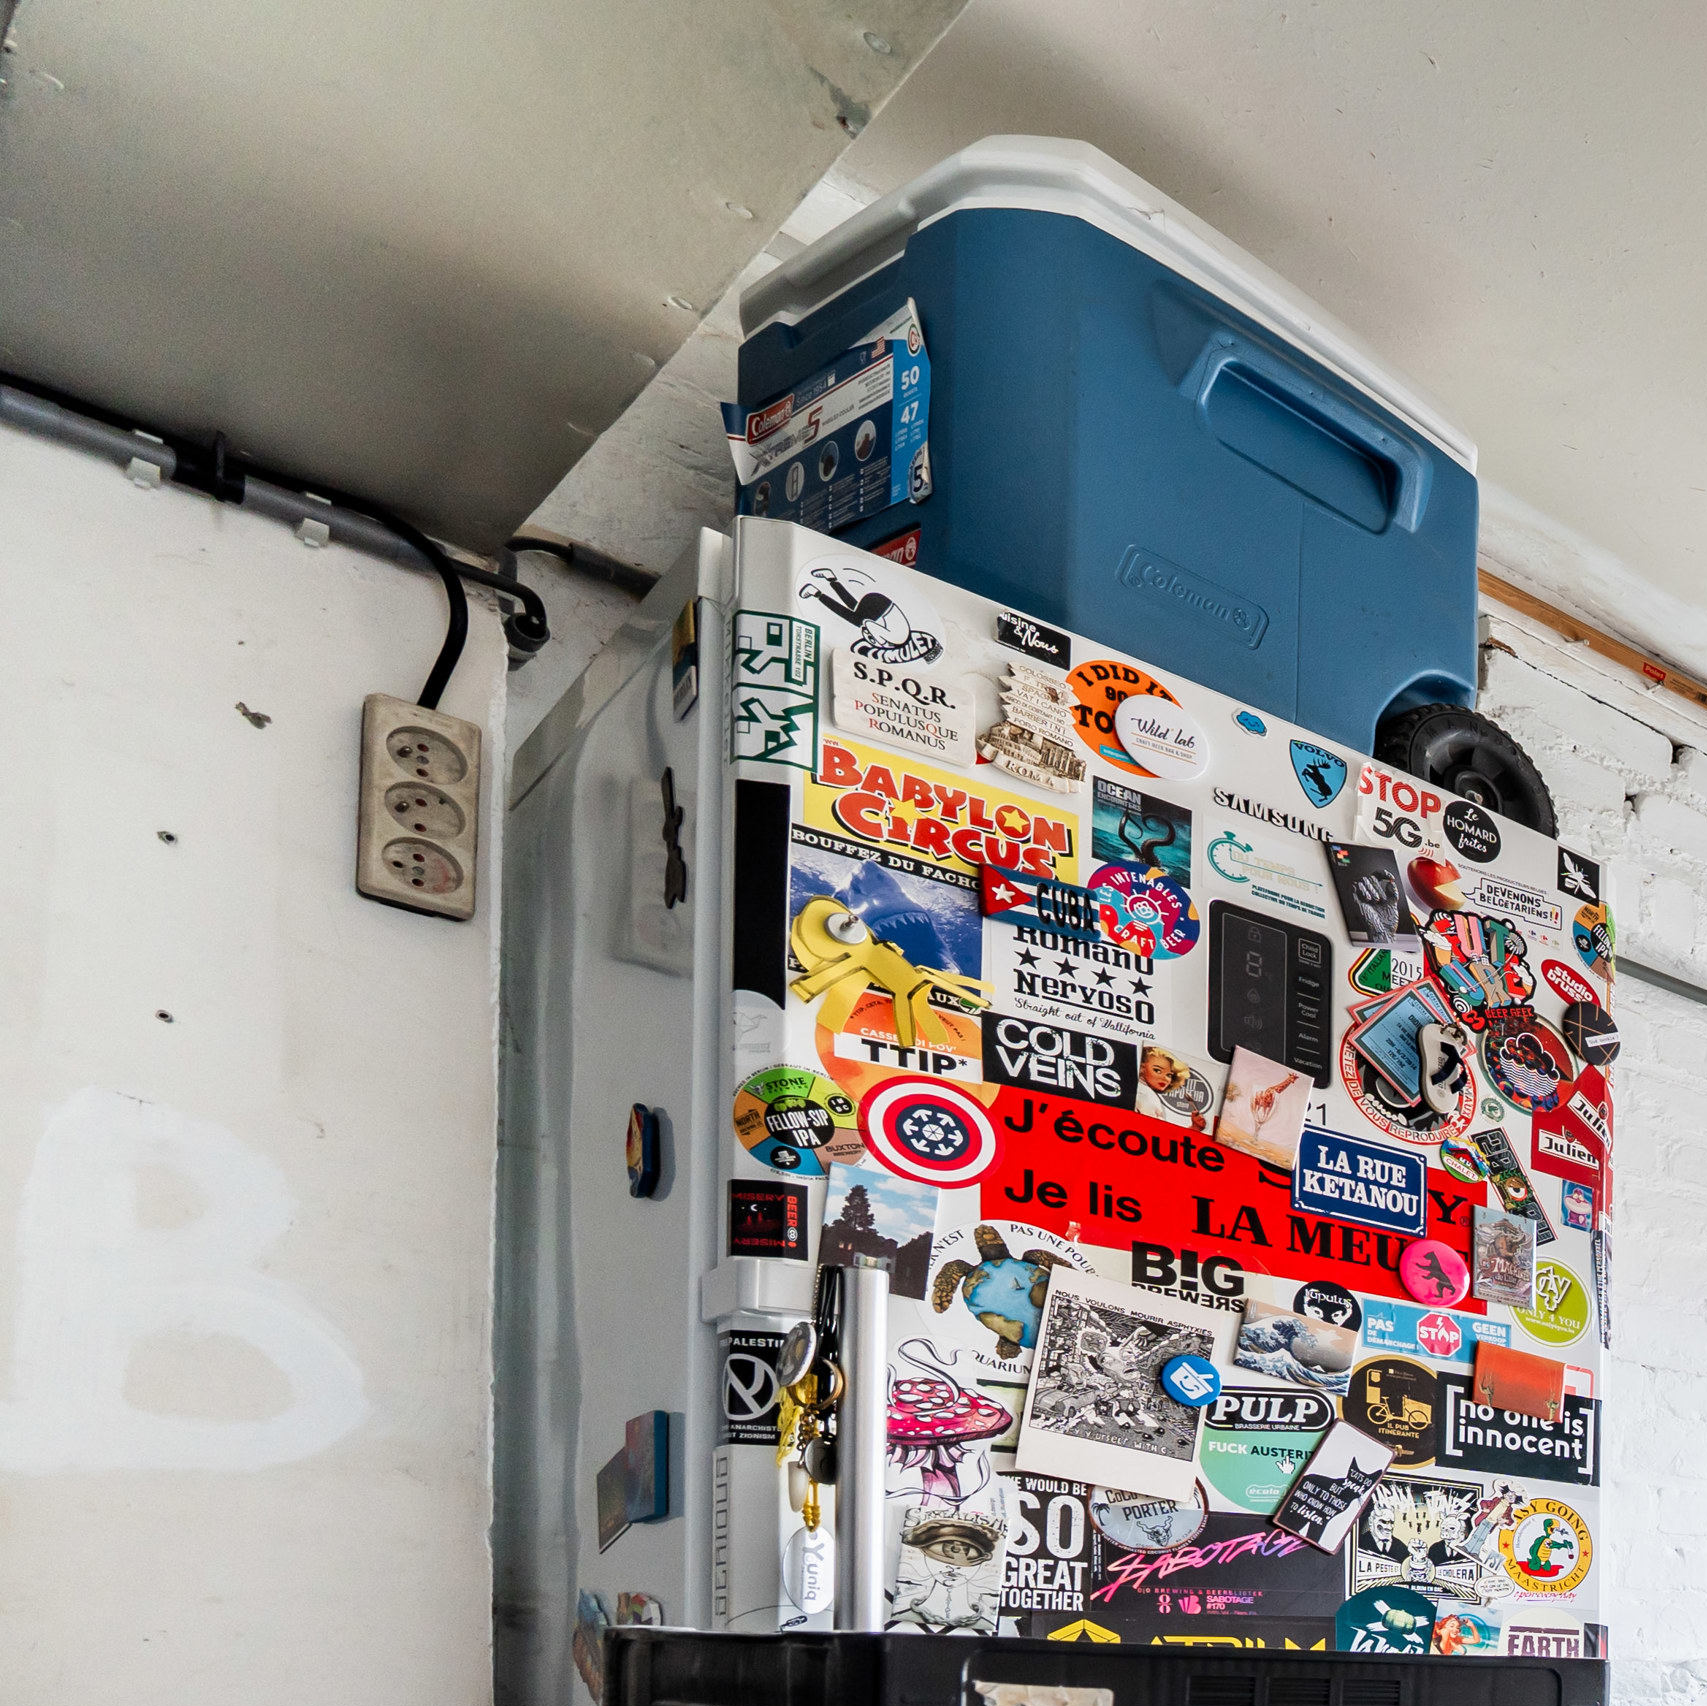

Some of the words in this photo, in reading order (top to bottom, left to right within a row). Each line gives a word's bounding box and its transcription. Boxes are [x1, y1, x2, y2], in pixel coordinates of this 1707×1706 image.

[902, 366, 920, 390] 50
[901, 402, 919, 424] 47
[1140, 562, 1231, 621] Coleman
[804, 626, 814, 660] BERLIN
[1022, 629, 1059, 654] Nous
[853, 661, 957, 710] S.P.Q.R.
[1076, 671, 1094, 687] I
[1089, 664, 1140, 685] DID
[854, 699, 960, 743] POPULUSQUE
[871, 692, 942, 724] SENATUS
[1012, 705, 1067, 736] BARBERINI
[868, 717, 947, 751] ROMANUS
[1130, 717, 1171, 741] Wild
[1173, 728, 1196, 749] lab
[1292, 740, 1346, 770] VOLVO
[1005, 760, 1055, 788] ROMA
[818, 744, 1069, 854] BABYLON
[1096, 780, 1142, 806] OCEAN
[1358, 765, 1443, 820] STOP
[1212, 787, 1335, 844] SAMSUNG
[1372, 806, 1423, 849] 5G
[1463, 807, 1480, 822] Le
[836, 794, 1058, 882] CIRCUS
[1445, 814, 1498, 845] HOMARD
[791, 828, 883, 862] BOUFFEZ
[888, 856, 915, 871] DU
[1457, 832, 1489, 855] frites
[1254, 856, 1296, 877] TEMPS
[1098, 882, 1116, 904] LES
[1110, 870, 1184, 910] INTENABLES
[1277, 874, 1311, 892] NOUS
[1485, 883, 1542, 909] DEVENONS
[1036, 882, 1096, 935] CUBA
[1112, 923, 1155, 951] CRAFT
[1160, 928, 1188, 951] BEER
[1595, 941, 1609, 959] IPA
[1298, 976, 1320, 988] Fridge
[1391, 957, 1423, 980] 2015
[1553, 965, 1594, 1002] studio
[1298, 1002, 1319, 1013] Power
[1301, 1009, 1317, 1019] Cool
[1484, 1008, 1506, 1019] BEER
[1509, 1007, 1534, 1018] GEEK
[1065, 1010, 1083, 1023] out
[1086, 1013, 1098, 1029] of
[1100, 1017, 1157, 1041] Wallifornia
[1298, 1032, 1319, 1043] Alarm
[995, 1017, 1116, 1068] COLD
[994, 1044, 1123, 1100] VEINS
[1293, 1056, 1323, 1070] Vacation
[766, 1076, 807, 1091] STONE
[735, 1109, 761, 1127] NORTH
[765, 1108, 830, 1133] FELLOW-SIP
[1346, 1080, 1362, 1099] DE
[1359, 1097, 1388, 1128] VOUS
[1389, 1123, 1459, 1143] REPRODUIRE
[1573, 1098, 1613, 1149] Julien
[792, 1128, 822, 1148] IPA
[825, 1142, 866, 1152] BUXTON
[1003, 1098, 1226, 1173] J'écoute
[1544, 1134, 1598, 1165] Julien
[1317, 1144, 1352, 1175] LA
[1356, 1154, 1407, 1189] RUE
[1445, 1157, 1477, 1180] CHALET
[730, 1192, 786, 1203] MISERY
[1302, 1169, 1420, 1217] KETANOU
[786, 1195, 798, 1228] BEER
[1004, 1168, 1068, 1209] Je
[1088, 1180, 1143, 1223] lis
[1190, 1194, 1273, 1249] LA
[937, 1229, 966, 1253] N'EST
[1009, 1223, 1035, 1238] PAS
[1037, 1230, 1064, 1251] UNE
[1054, 1288, 1081, 1302] NOUS
[1084, 1296, 1127, 1315] VOULONS
[1129, 1309, 1165, 1325] MOURIR
[1516, 1303, 1546, 1320] ONLY
[1548, 1313, 1556, 1323] 4
[1557, 1315, 1581, 1330] YOU
[1366, 1316, 1395, 1333] PAS
[1366, 1328, 1378, 1337] DE
[1471, 1321, 1507, 1338] GEEN
[1475, 1333, 1507, 1344] VERKOOP
[1211, 1395, 1320, 1424] PULP
[1458, 1398, 1495, 1422] no
[1563, 1410, 1585, 1437] is
[739, 1432, 777, 1440] ZIONISM
[1234, 1423, 1271, 1432] BRASSERIE
[1271, 1424, 1300, 1432] URBAINE
[1378, 1427, 1421, 1439] ITINERANTE
[1395, 1423, 1410, 1431] PUB
[1458, 1418, 1584, 1461] innocent
[1134, 1440, 1160, 1452] WITH
[1208, 1440, 1248, 1455] FUCK
[1024, 1476, 1071, 1495] WOULD
[1071, 1480, 1088, 1497] BE
[1302, 1480, 1321, 1495] ONLY
[1320, 1490, 1330, 1501] TO
[1329, 1495, 1348, 1511] THOSE
[1328, 1482, 1344, 1496] BUT
[1121, 1500, 1180, 1522] PORTER
[1294, 1489, 1309, 1502] WHO
[1307, 1495, 1325, 1510] KNOW
[1322, 1504, 1338, 1517] HOW
[1003, 1492, 1086, 1559] SO
[1544, 1500, 1590, 1542] GOING
[1001, 1555, 1089, 1593] GREAT
[1358, 1561, 1374, 1574] LA
[1374, 1562, 1394, 1574] PESTE
[1443, 1567, 1476, 1582] CHOLERA
[1505, 1557, 1585, 1593] MAASTRICHT
[1000, 1588, 1084, 1613] TOGETHER
[1205, 1594, 1255, 1605] SABOTAGE
[1507, 1632, 1580, 1658] EARTH
